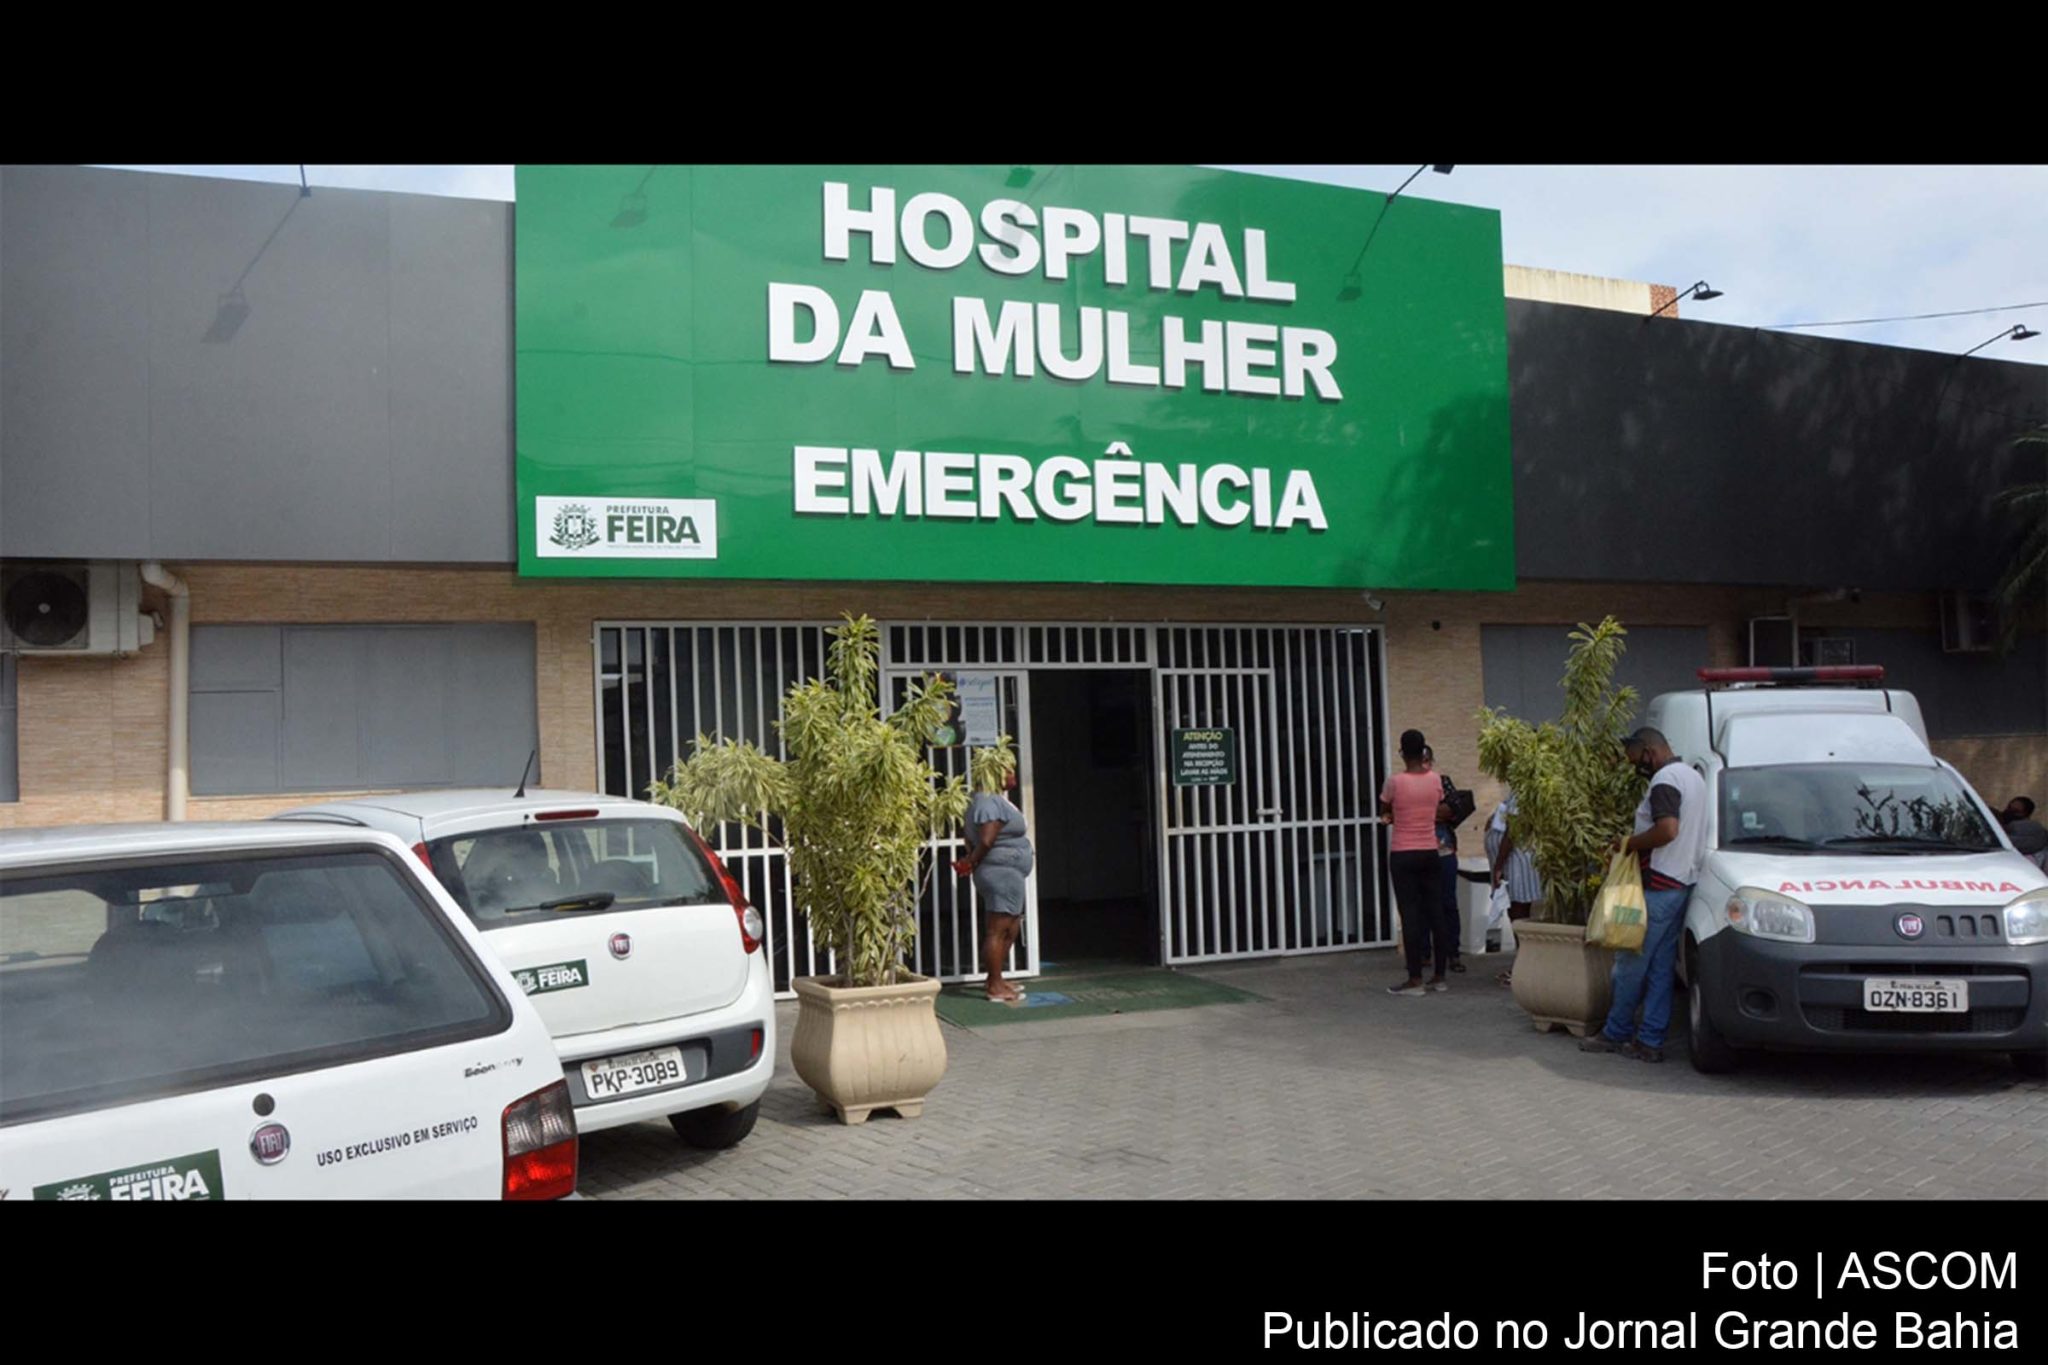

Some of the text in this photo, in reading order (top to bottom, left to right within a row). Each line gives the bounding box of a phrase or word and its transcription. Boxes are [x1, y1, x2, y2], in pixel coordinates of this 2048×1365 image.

[823, 182, 1296, 301] HOSPITAL
[769, 282, 1342, 399] DA MULHER
[795, 441, 1328, 529] EMERGÊNCIA
[606, 505, 669, 514] PREFEITURA
[607, 515, 701, 543] FEIRA
[1183, 730, 1223, 742] ATENÇÃO
[538, 967, 582, 988] FEIRA
[317, 1115, 478, 1167] USO EXCLUSIVO EM SERVIÇO
[109, 1165, 176, 1186] PREFEITURA
